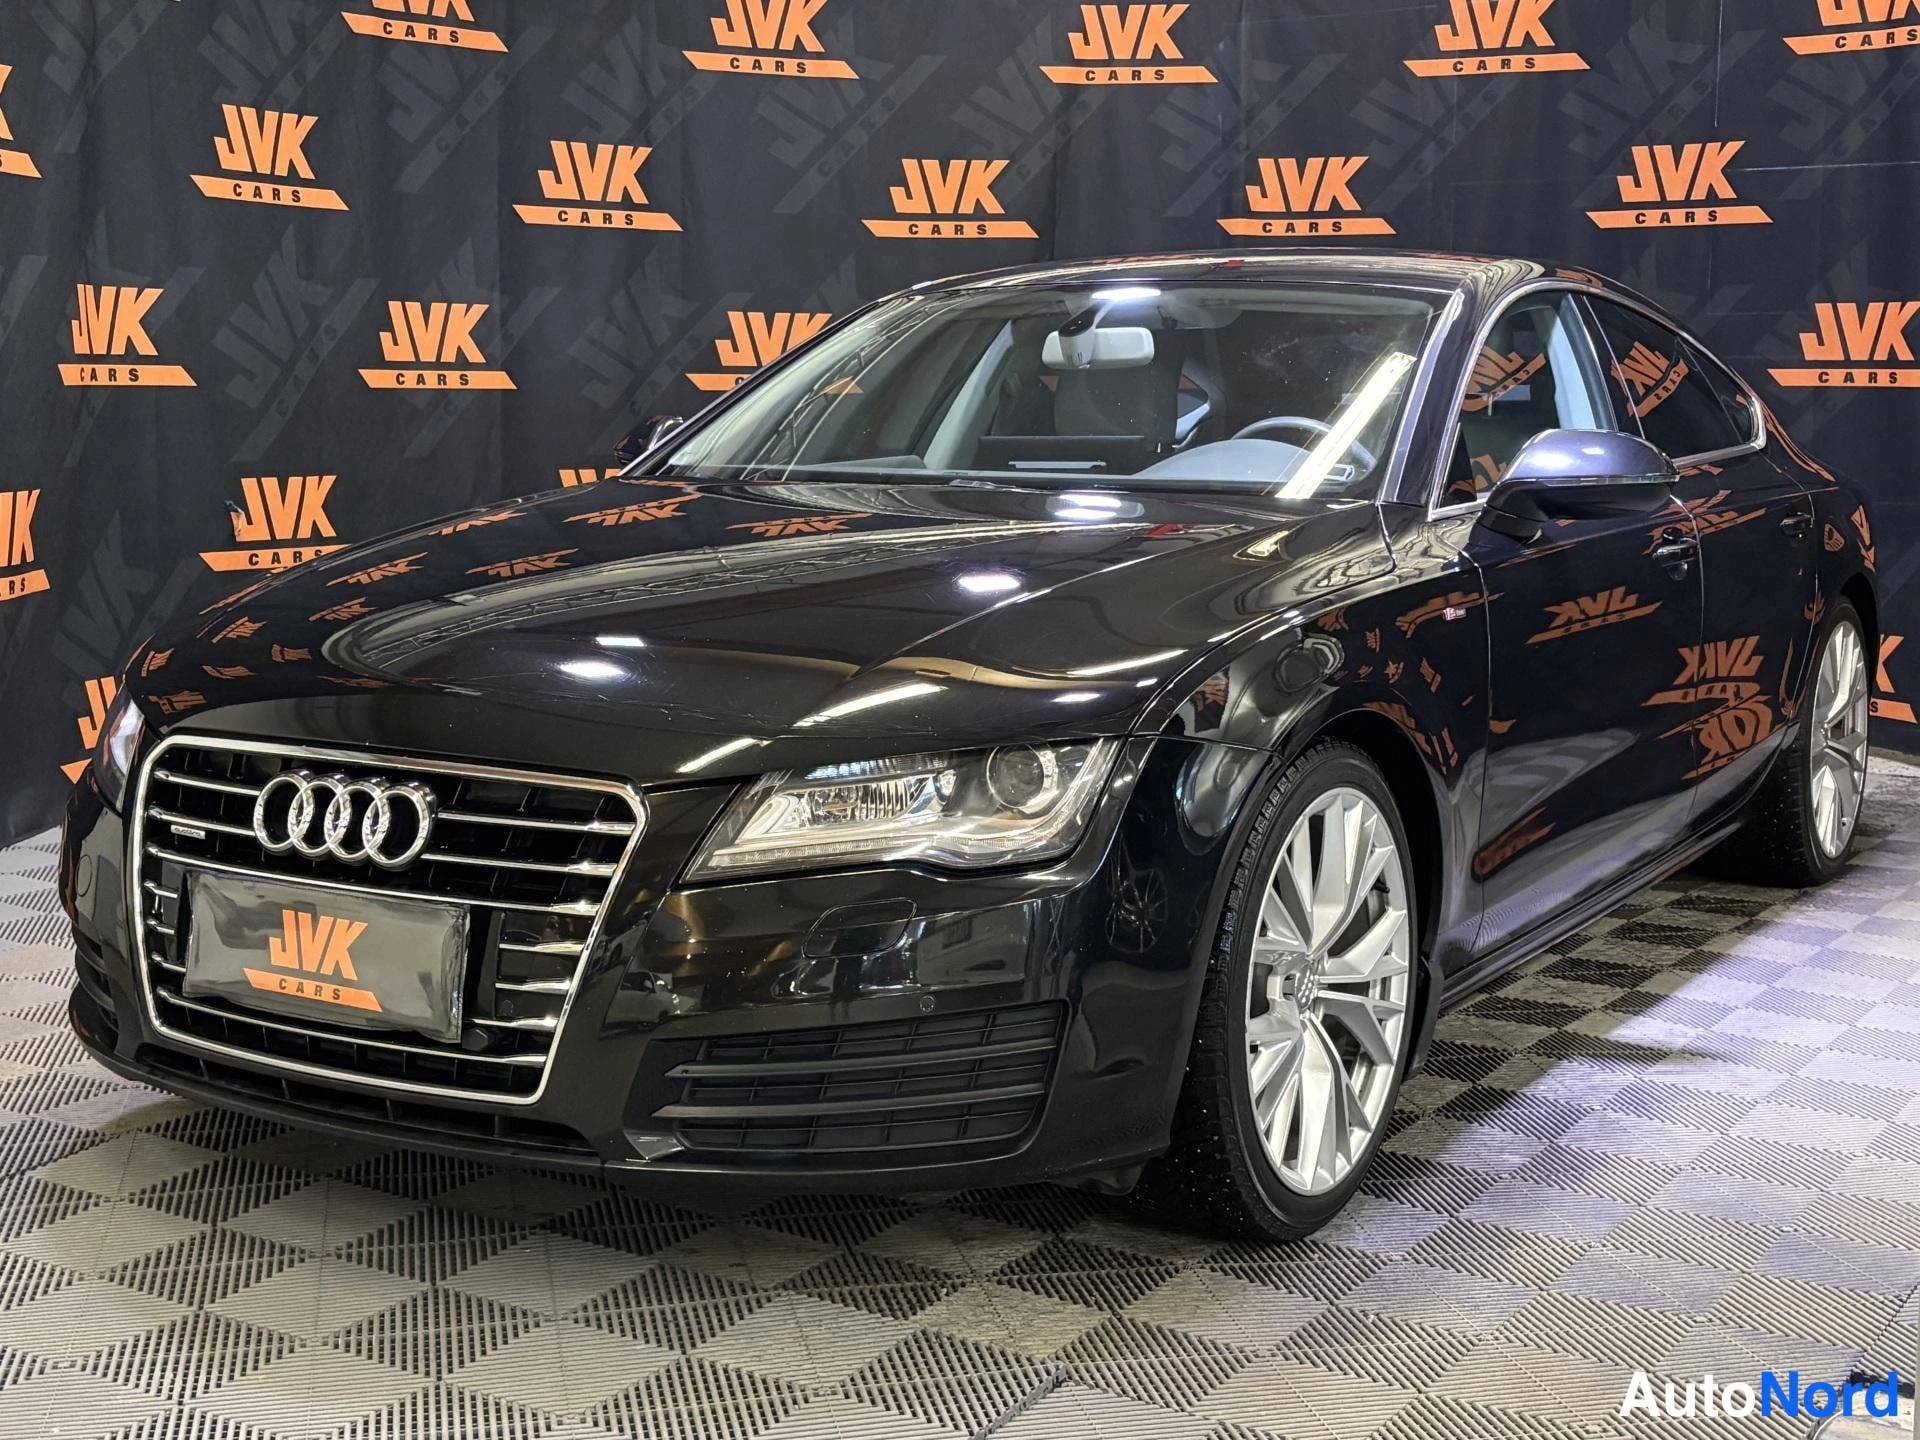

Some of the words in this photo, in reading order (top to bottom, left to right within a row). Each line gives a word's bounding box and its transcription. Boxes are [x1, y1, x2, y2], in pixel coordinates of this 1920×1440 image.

[383, 22, 458, 42] CARS
[711, 0, 826, 52] JVK
[1069, 4, 1186, 60] JVK
[1435, 0, 1552, 51] JVK
[1836, 29, 1918, 48] CARS
[730, 58, 805, 73] CARS
[1086, 69, 1164, 81] CARS
[1453, 57, 1535, 73] CARS
[216, 104, 316, 179] JVK
[540, 143, 651, 204] JVK
[1620, 141, 1743, 202] JVK
[233, 184, 300, 202] CARS
[891, 159, 1009, 214] JVK
[1246, 156, 1366, 212] JVK
[558, 210, 633, 225] CARS
[1263, 221, 1341, 233] CARS
[1635, 210, 1717, 224] CARS
[909, 224, 986, 235] CARS
[72, 284, 162, 355] JVK
[1800, 301, 1920, 360] JVK
[380, 302, 487, 363] JVK
[80, 368, 139, 382] CARS
[396, 372, 468, 385] CARS
[1818, 372, 1897, 384] CARS
[232, 475, 336, 542] JVK
[269, 909, 368, 981] JVK
[278, 978, 341, 1000] CARS
